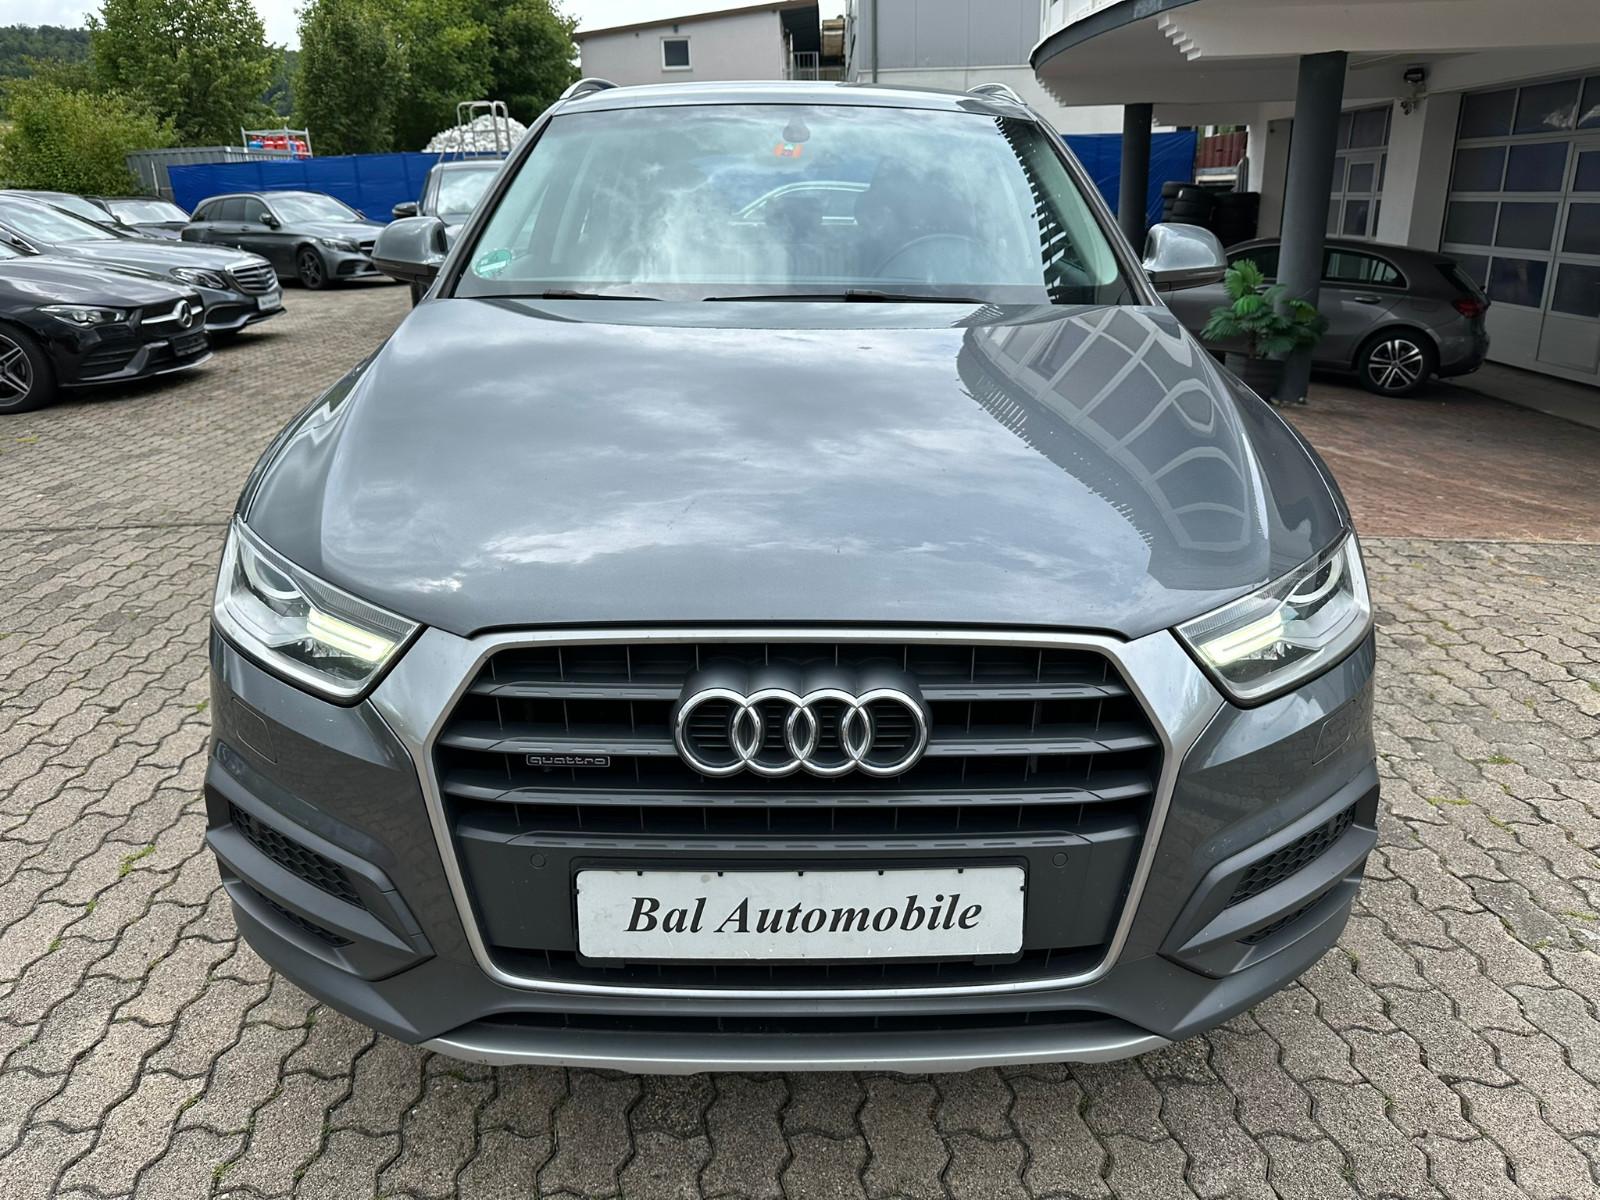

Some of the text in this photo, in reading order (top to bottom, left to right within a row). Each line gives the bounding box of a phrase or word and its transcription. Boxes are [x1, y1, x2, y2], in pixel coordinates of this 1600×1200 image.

[529, 756, 606, 766] quattro
[623, 893, 982, 934] Bal Automobile
